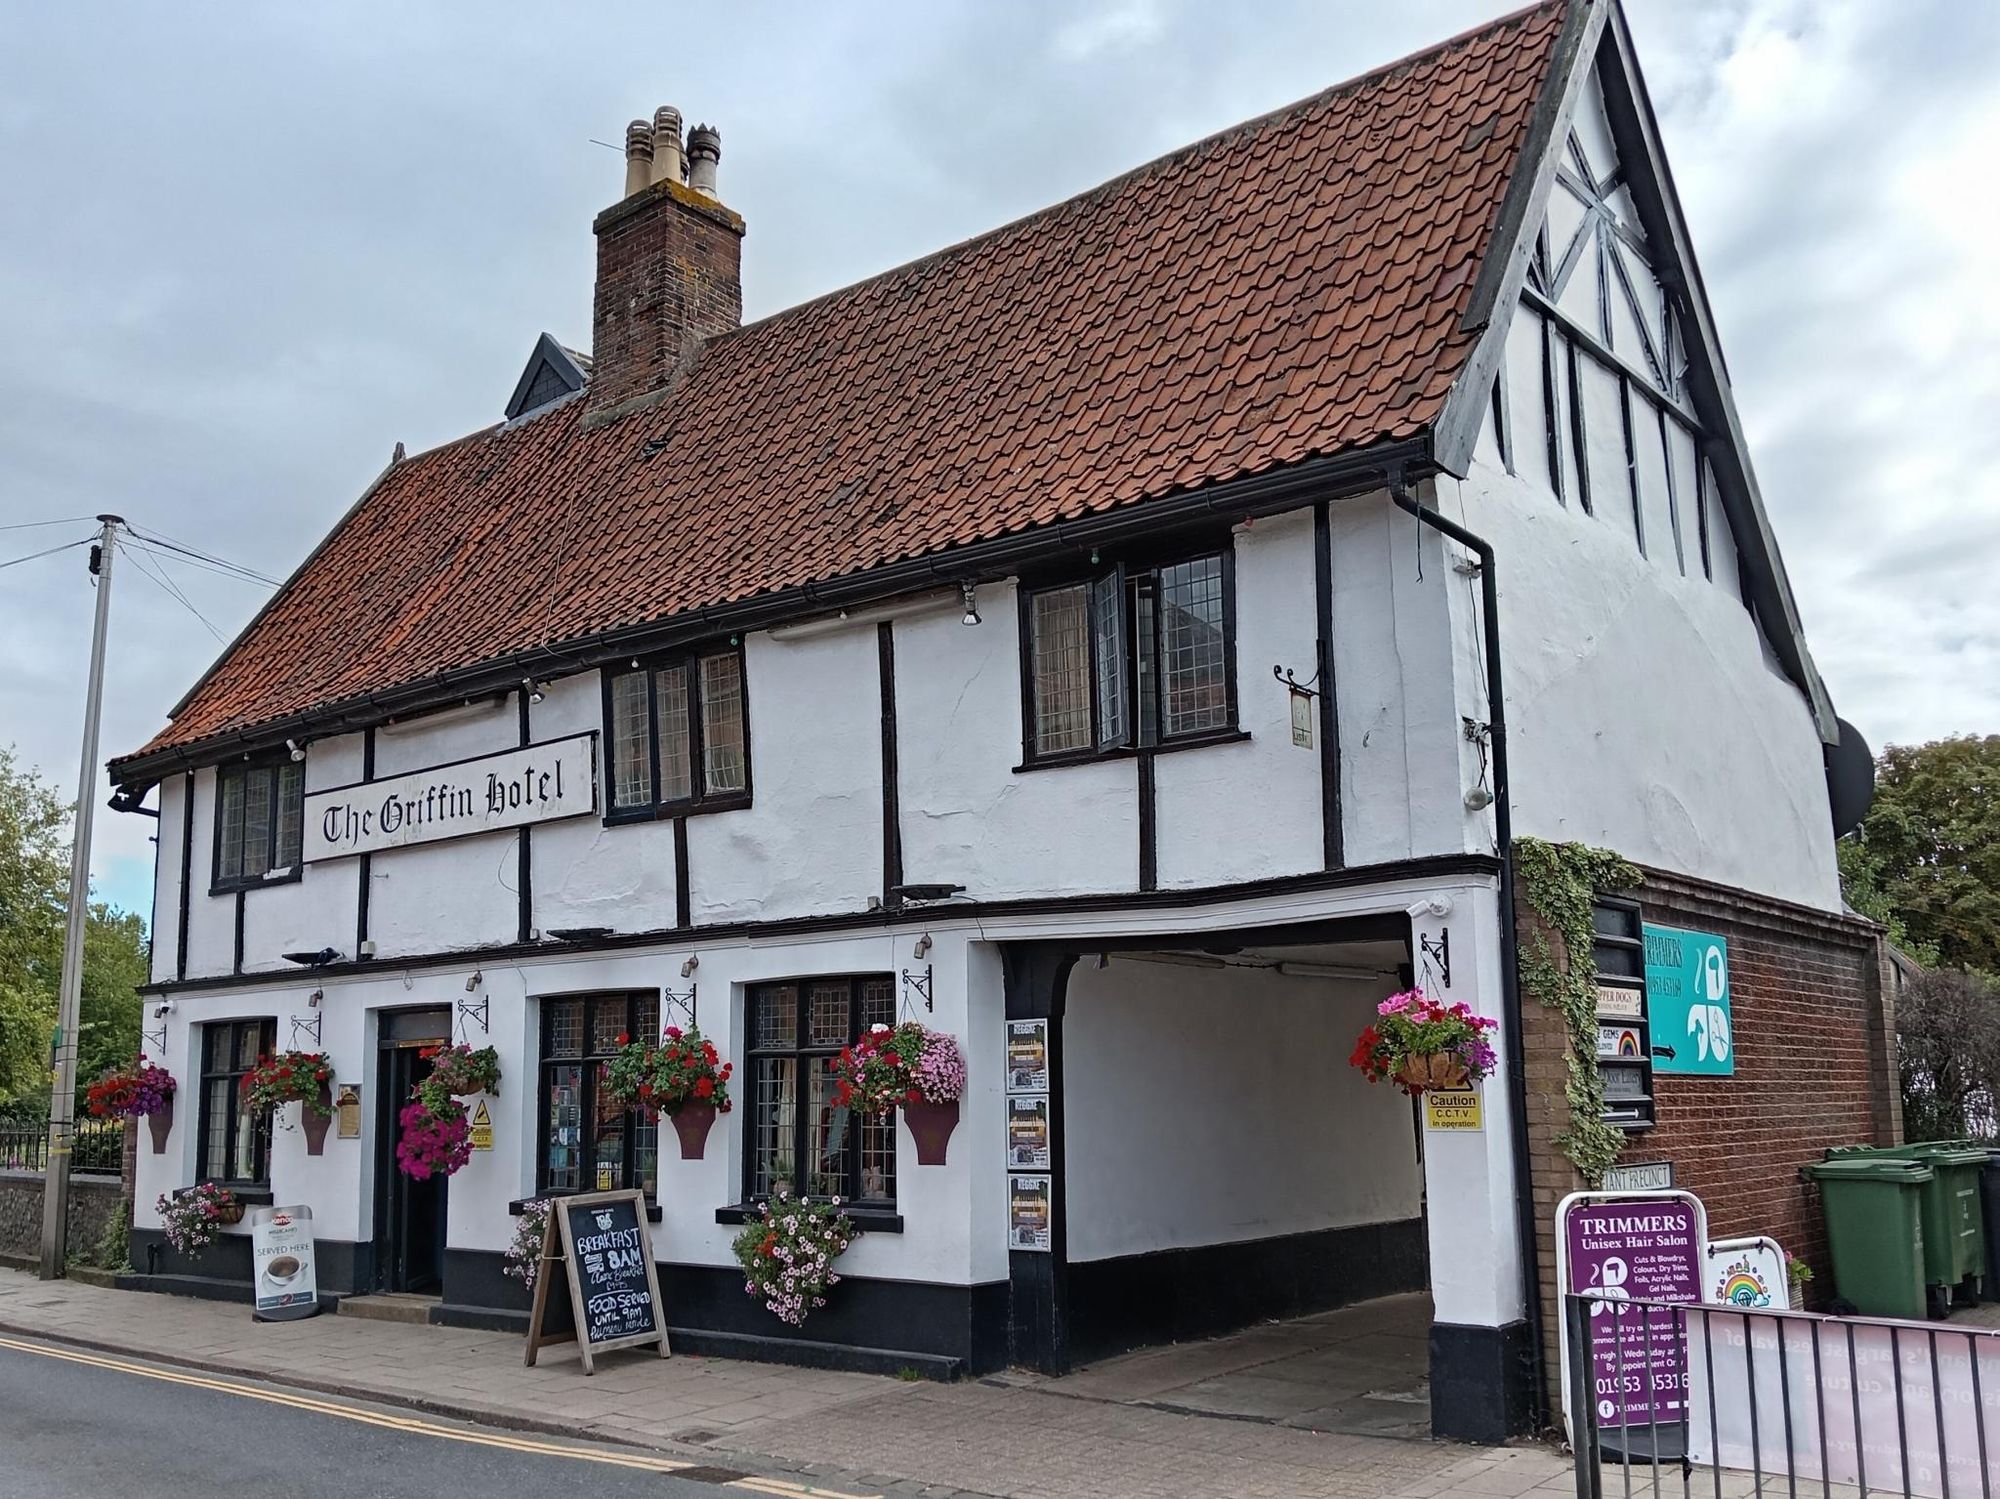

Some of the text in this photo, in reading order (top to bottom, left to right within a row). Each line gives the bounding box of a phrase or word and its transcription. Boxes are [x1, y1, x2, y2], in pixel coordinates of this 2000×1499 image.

[323, 758, 563, 848] The Griffin Hotel
[1603, 1029, 1619, 1039] GEMS
[1430, 1095, 1476, 1106] Caution
[1441, 1120, 1476, 1129] operation
[1630, 1167, 1667, 1190] PRECINCT
[1580, 1215, 1687, 1235] TRIMMERS
[577, 1227, 639, 1255] BREAKFAST
[1582, 1234, 1688, 1250] Unisex Hair Salon
[257, 1243, 310, 1257] SERVED HERE
[607, 1246, 643, 1270] 8AM
[1634, 1256, 1649, 1264] Cuts
[1650, 1255, 1656, 1263] &
[1659, 1265, 1671, 1273] Dry
[1651, 1274, 1672, 1283] Acrylic
[588, 1291, 651, 1315] FOOD SERVED
[595, 1312, 620, 1326] UNTIL
[1601, 1326, 1612, 1334] We
[1626, 1325, 1636, 1333] try
[1649, 1322, 1673, 1330] hardest
[1606, 1362, 1616, 1372] By
